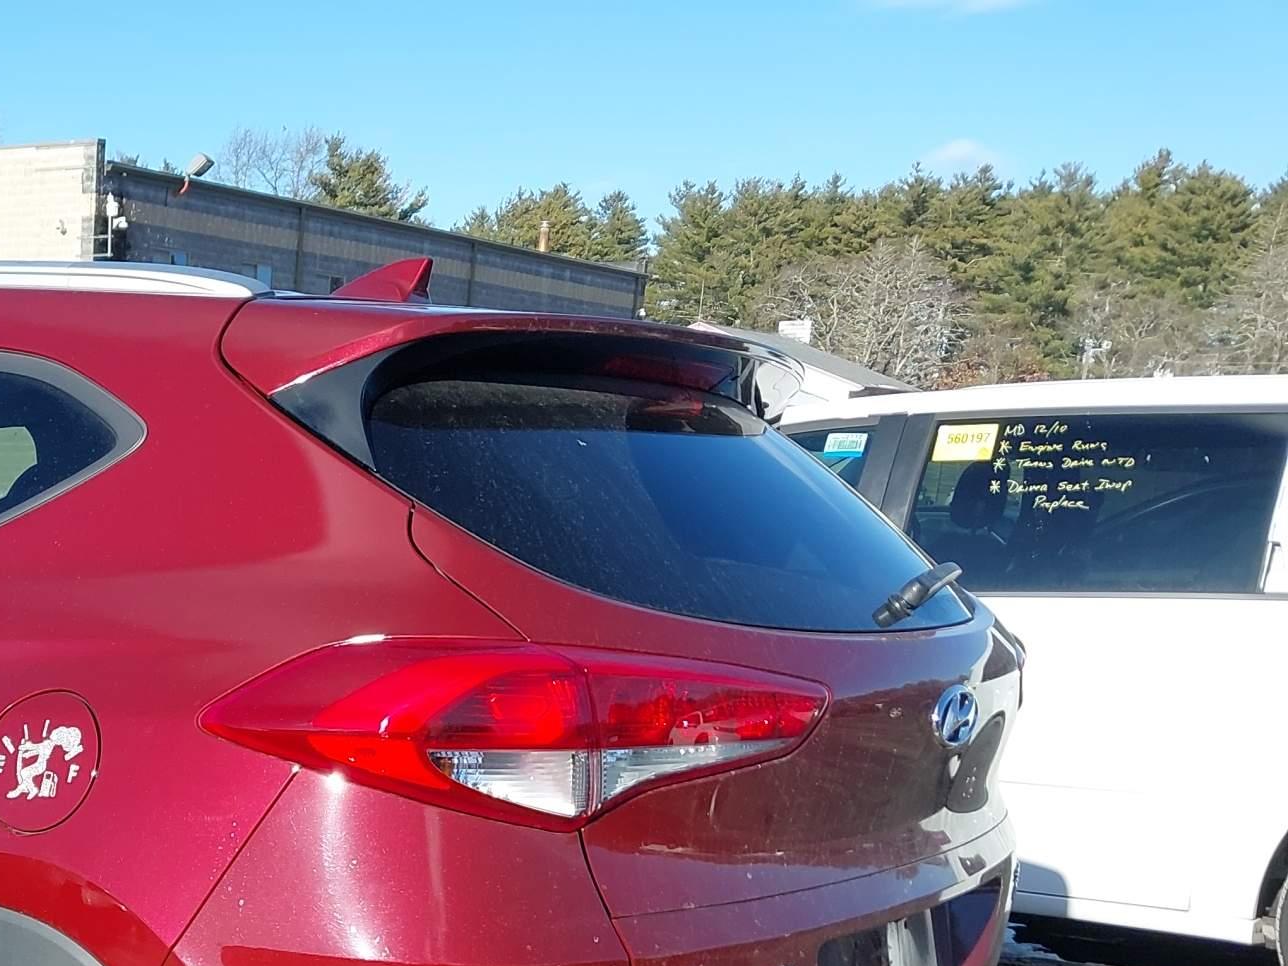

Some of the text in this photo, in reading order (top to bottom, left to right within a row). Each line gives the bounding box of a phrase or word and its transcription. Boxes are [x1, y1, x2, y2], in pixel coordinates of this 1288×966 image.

[1033, 421, 1068, 437] 12/10
[946, 432, 992, 445] 560197
[66, 764, 80, 783] F
